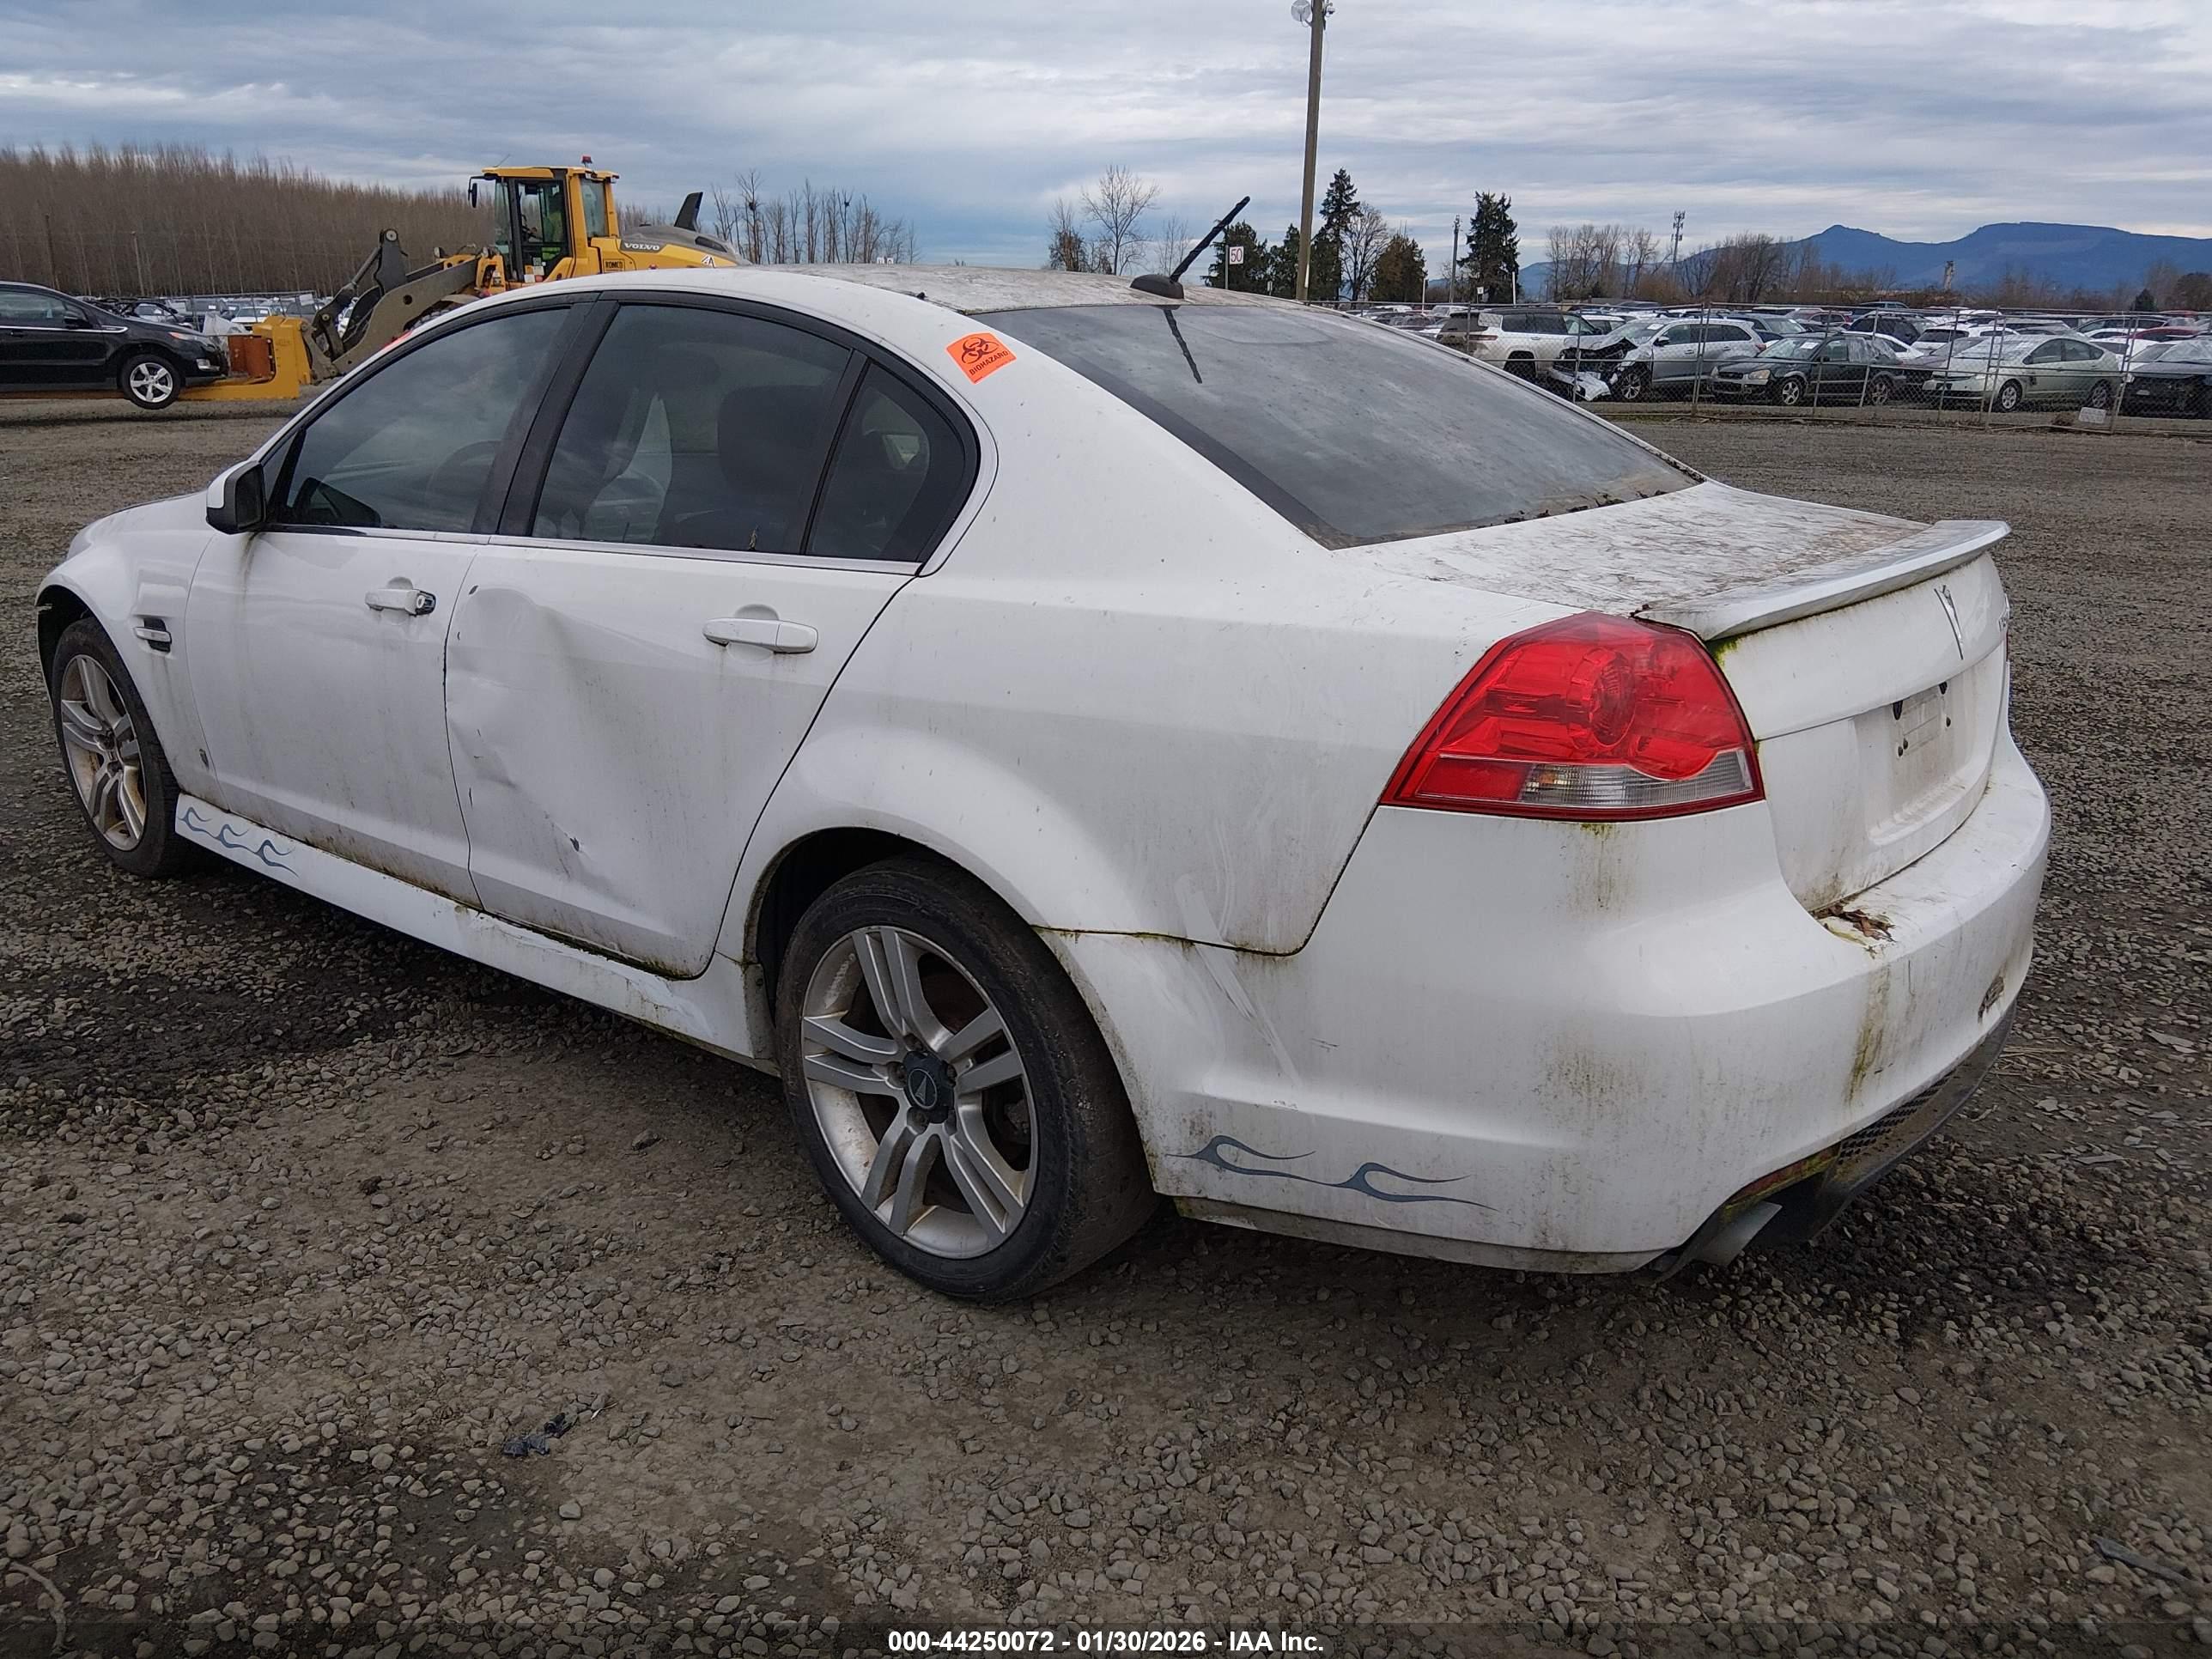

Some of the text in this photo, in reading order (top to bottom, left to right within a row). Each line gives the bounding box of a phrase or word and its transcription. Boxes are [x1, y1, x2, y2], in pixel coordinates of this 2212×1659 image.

[624, 242, 660, 251] VOLVO
[1231, 247, 1243, 263] 50
[969, 349, 1009, 376] BIOHAZARD
